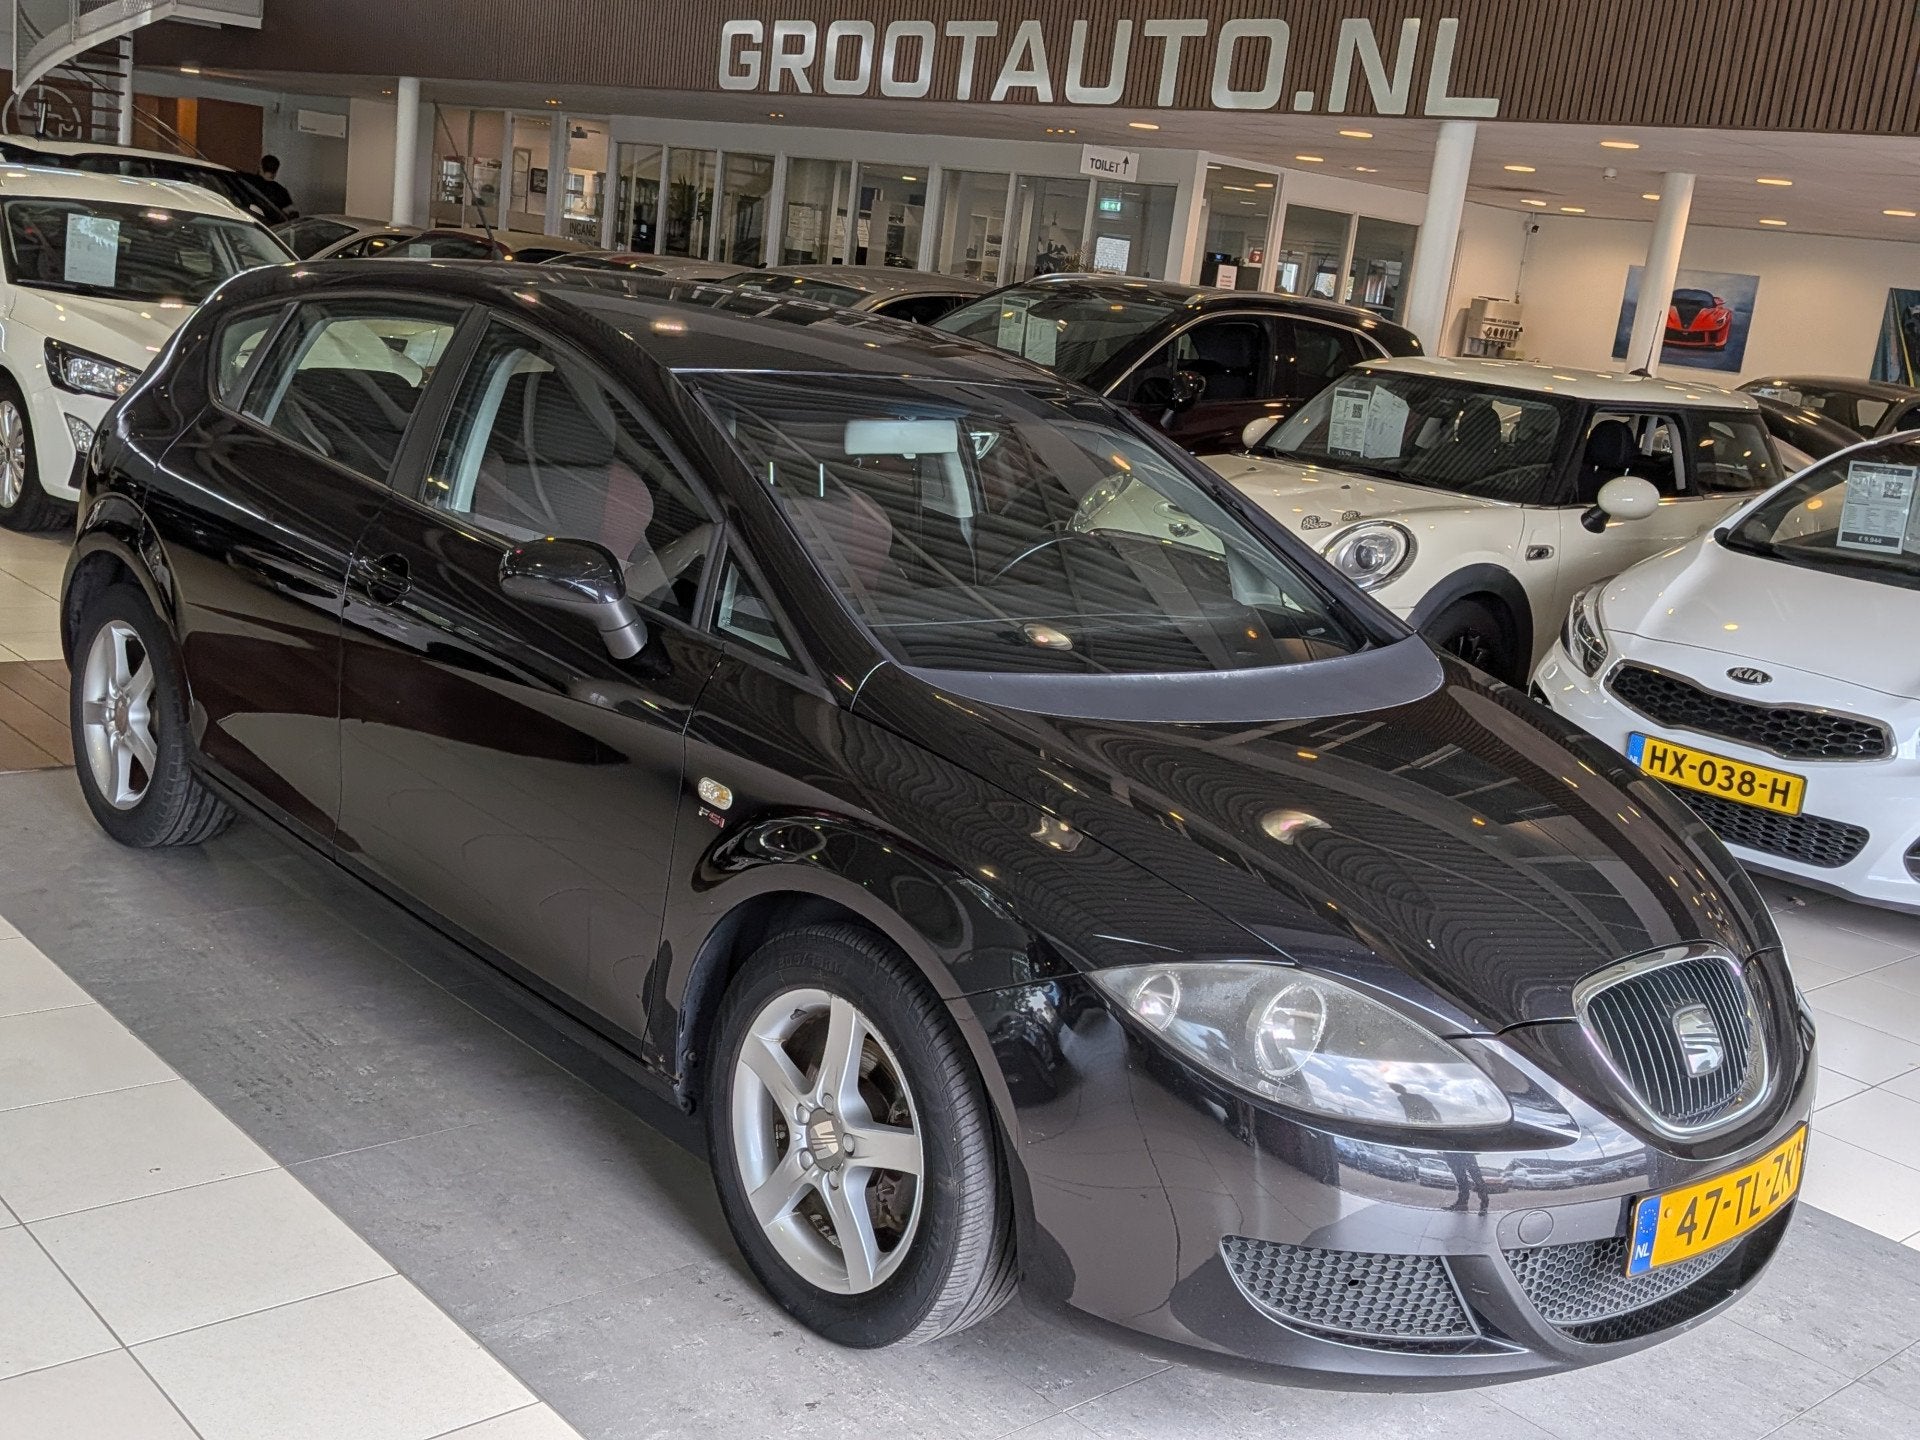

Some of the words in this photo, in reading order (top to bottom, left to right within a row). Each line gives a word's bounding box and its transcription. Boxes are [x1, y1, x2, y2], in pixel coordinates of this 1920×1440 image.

[718, 18, 1500, 119] GROOTAUTO.NL
[1090, 157, 1121, 173] TOILET
[569, 222, 597, 237] INGANG
[1732, 667, 1763, 683] KIA
[1649, 745, 1791, 807] HX-038-H
[698, 806, 725, 828] FSI
[1676, 1143, 1797, 1246] 47-TL-ZK
[1634, 1242, 1650, 1260] NL
